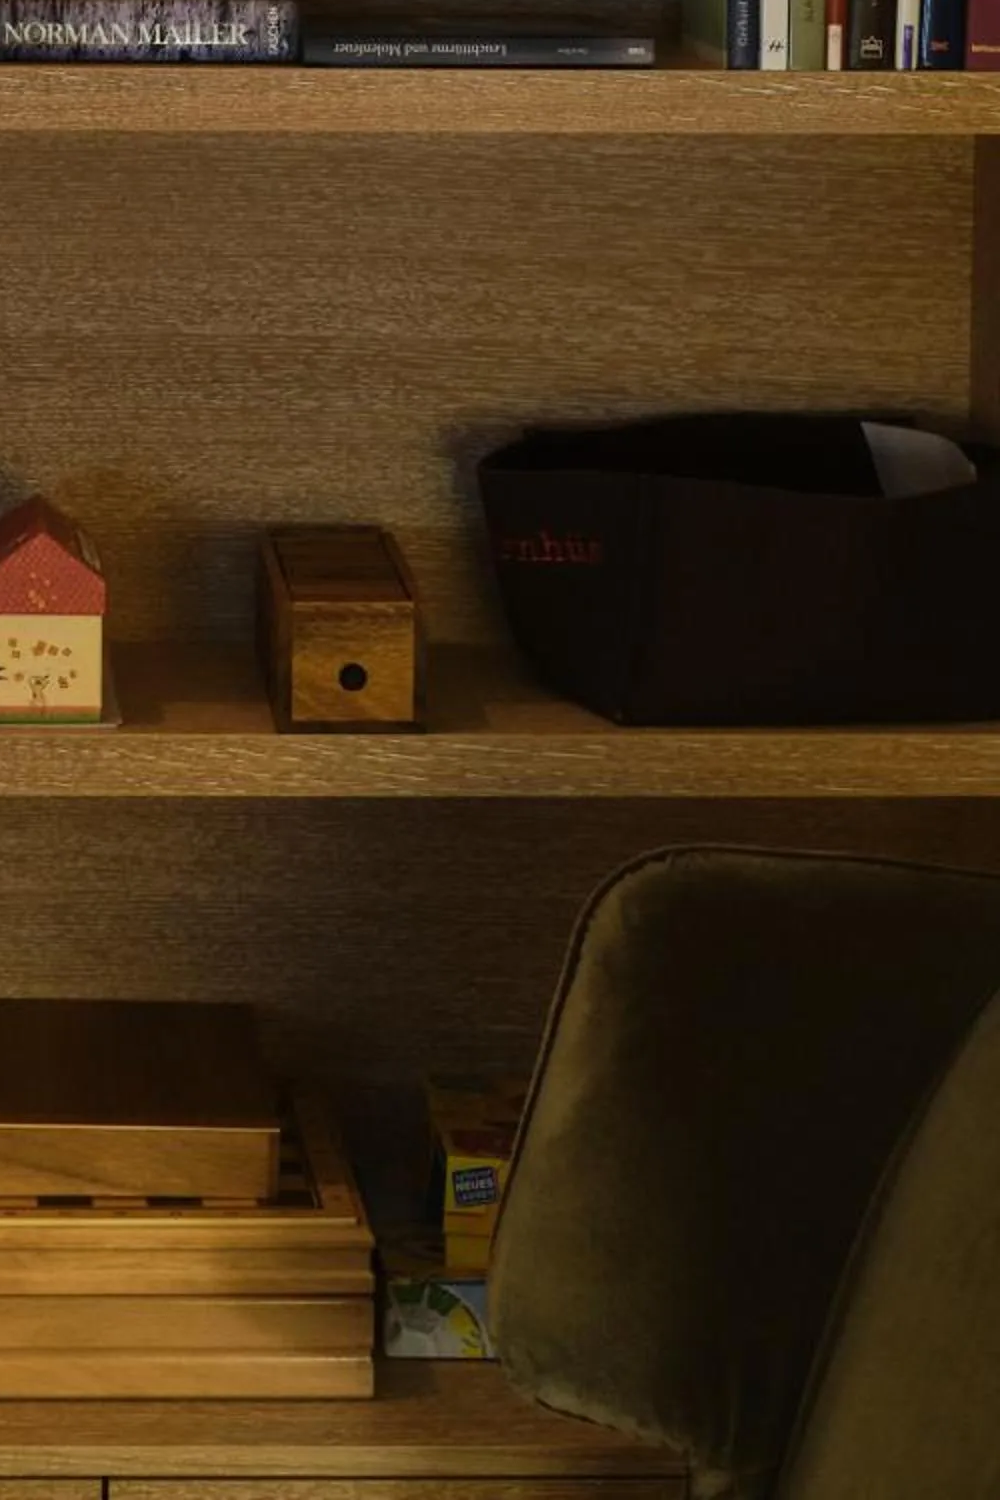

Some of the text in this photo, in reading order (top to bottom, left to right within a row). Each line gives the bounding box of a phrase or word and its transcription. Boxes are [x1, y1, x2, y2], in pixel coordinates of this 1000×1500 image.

[4, 21, 248, 45] NORMAN MAILER
[403, 44, 428, 56] und
